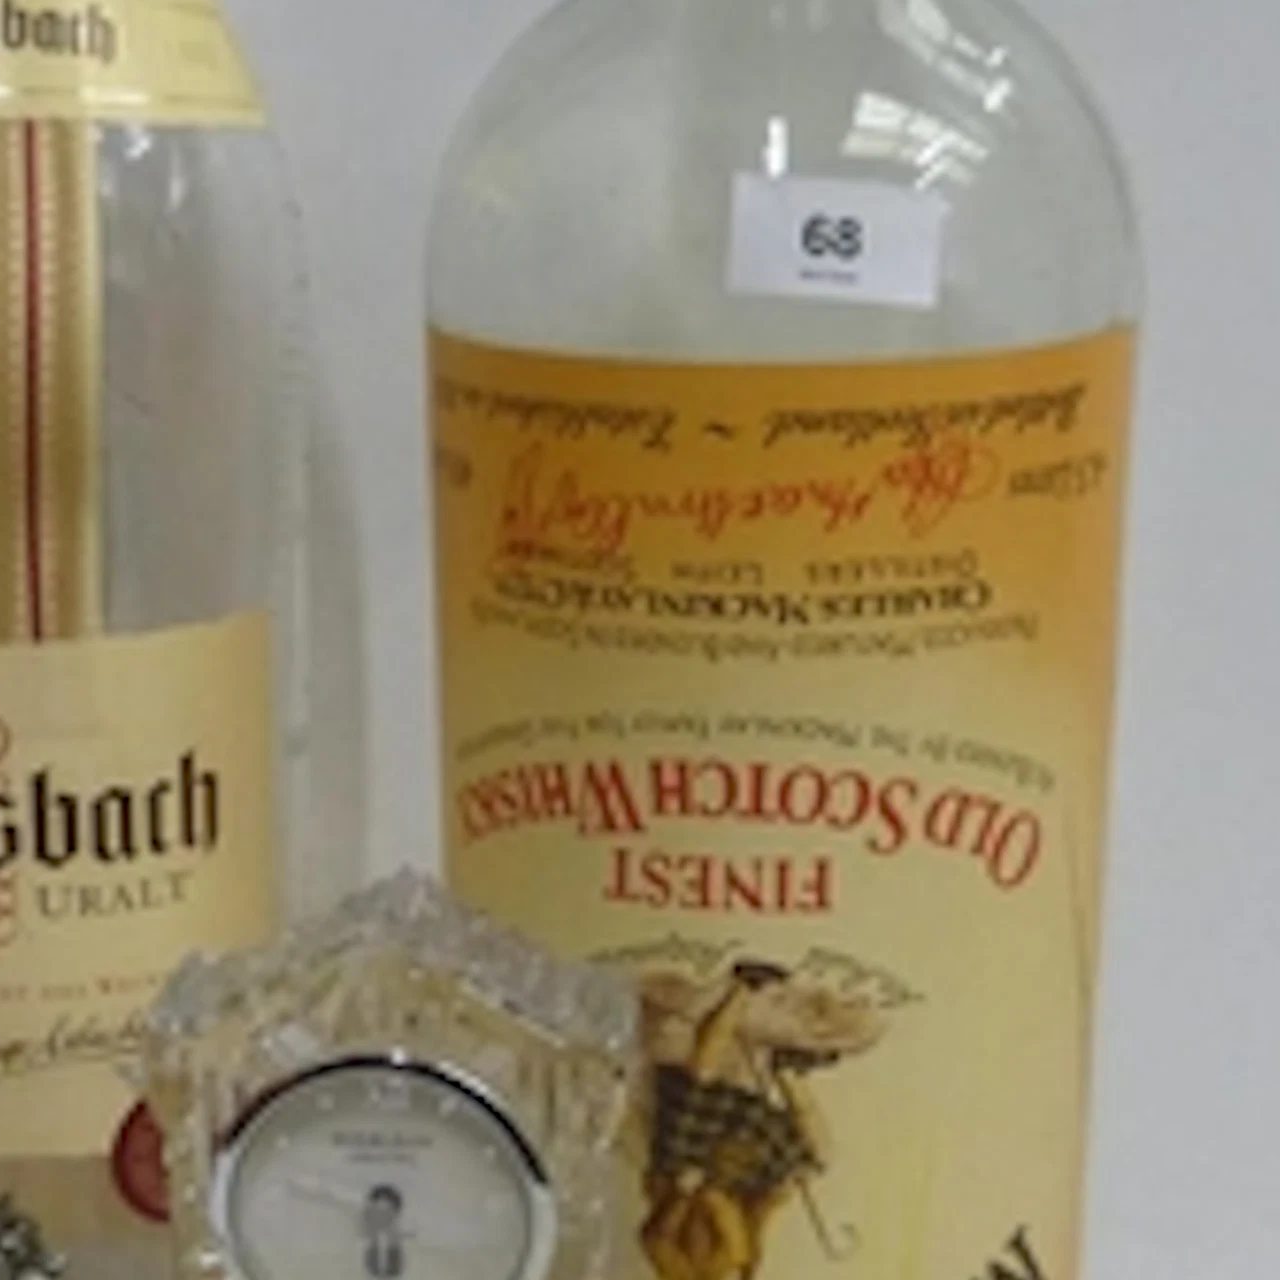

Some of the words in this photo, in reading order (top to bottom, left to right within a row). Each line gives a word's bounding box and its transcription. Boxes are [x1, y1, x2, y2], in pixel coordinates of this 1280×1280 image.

[801, 212, 862, 261] 68
[647, 757, 919, 858] SCOTCH
[923, 787, 1042, 892] OLD
[602, 848, 833, 916] FINEST
